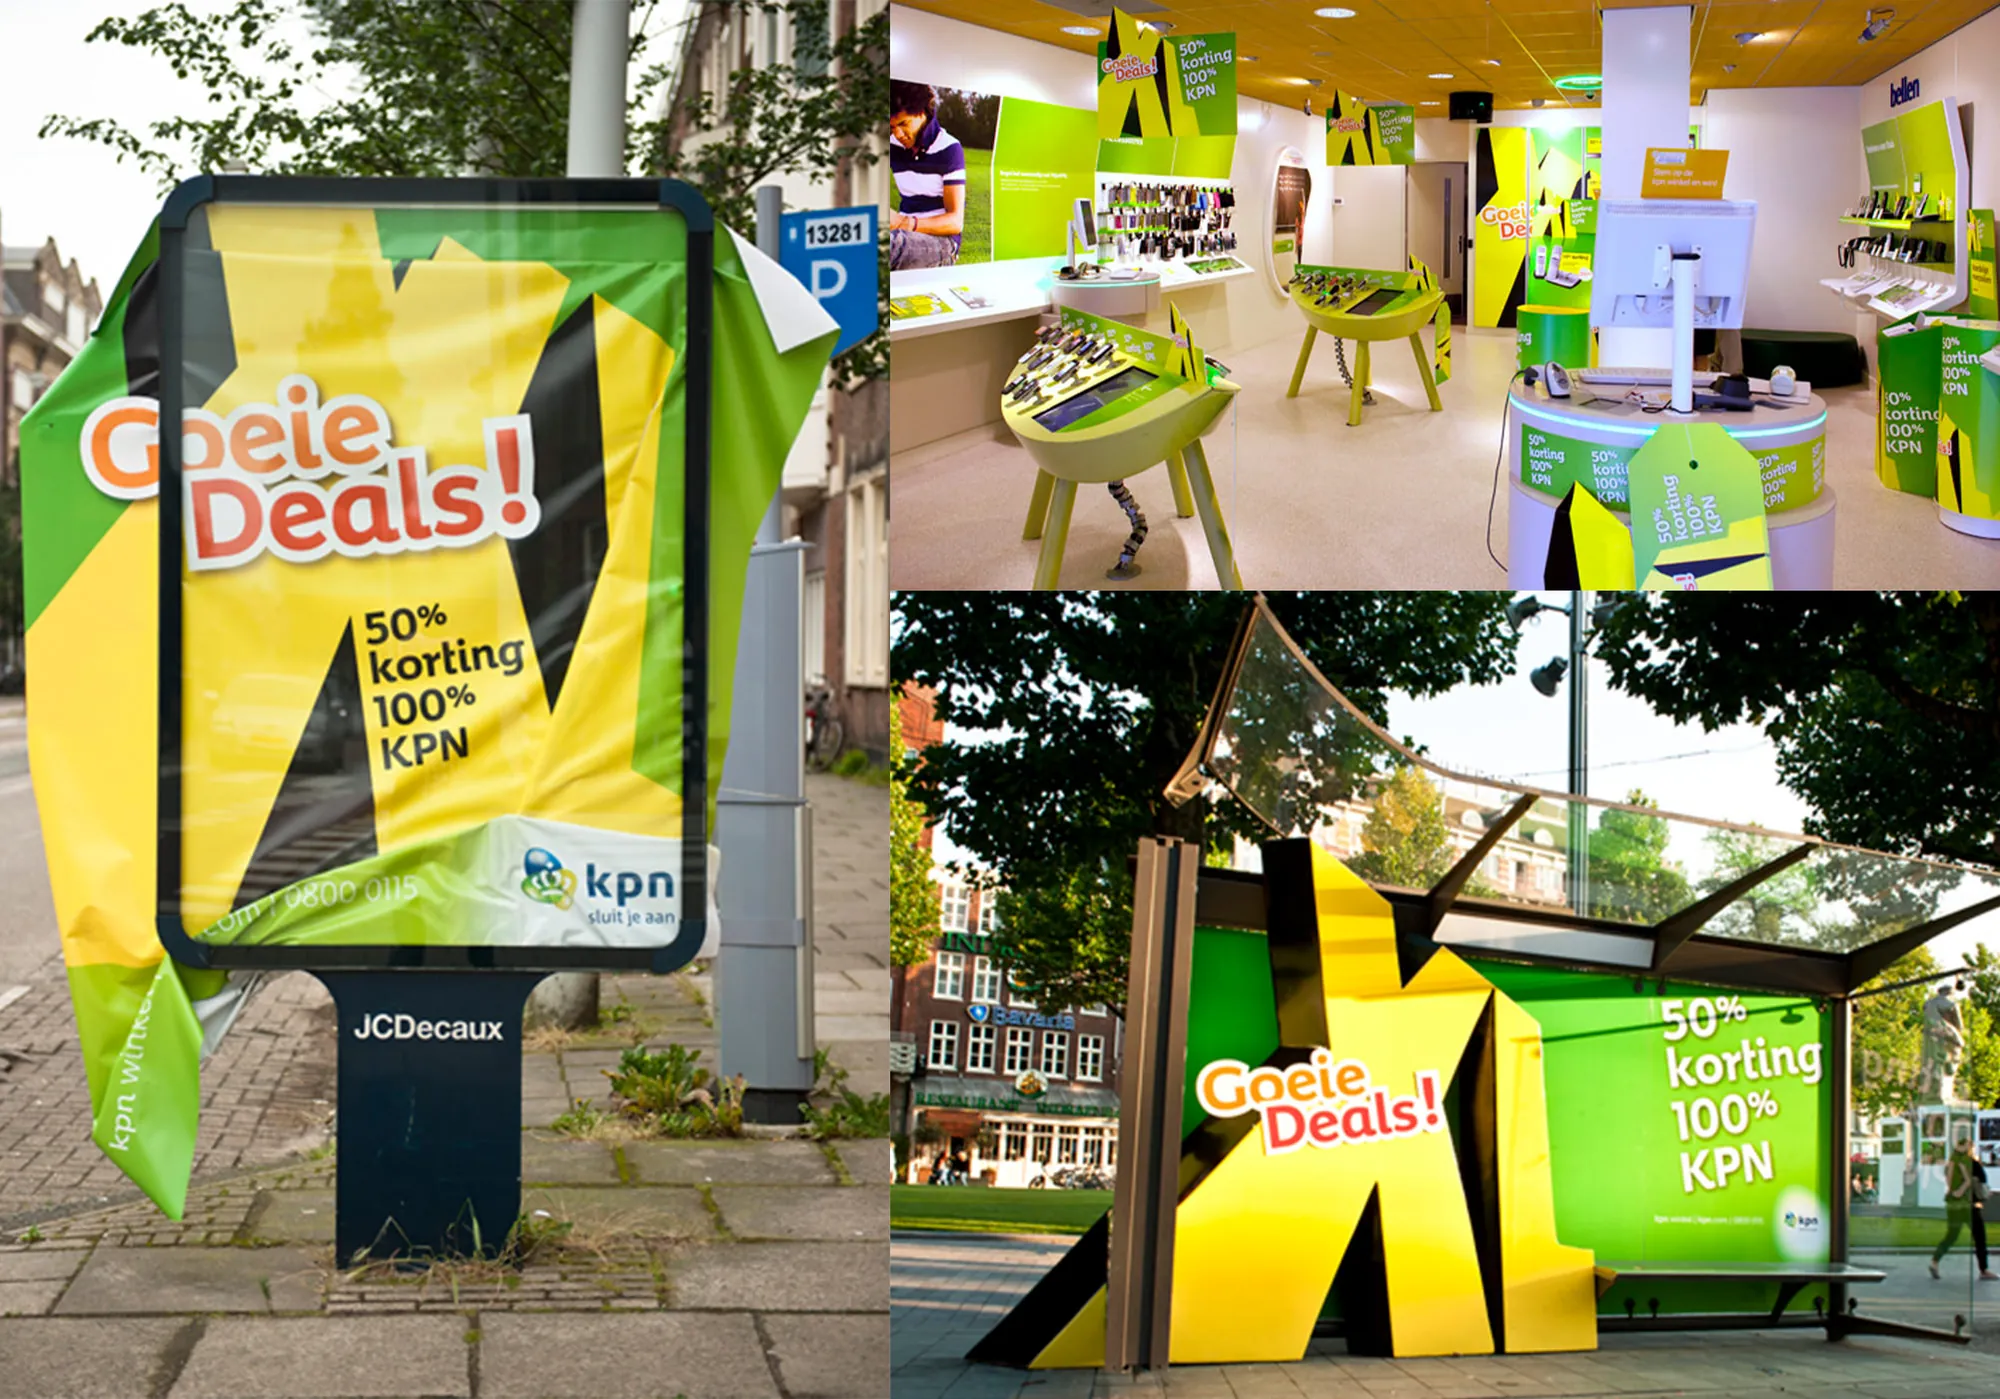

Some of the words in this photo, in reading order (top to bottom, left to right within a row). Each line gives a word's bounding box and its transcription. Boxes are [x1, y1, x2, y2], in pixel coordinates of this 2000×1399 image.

[1102, 54, 1139, 72] Goeie
[1179, 39, 1207, 57] 50%
[1181, 49, 1233, 71] korting
[1115, 58, 1158, 81] Deals!
[1183, 68, 1218, 86] 100%
[1186, 83, 1217, 101] KPN
[1890, 76, 1920, 108] bellen
[1380, 115, 1412, 127] korting
[1383, 135, 1402, 145] KPN
[806, 222, 862, 245] 13281
[811, 259, 848, 300] P
[91, 384, 380, 489] Goeie
[1528, 434, 1546, 446] 50%
[1886, 440, 1923, 454] KPN
[1529, 447, 1565, 464] korting
[1530, 459, 1553, 472] 100%
[1591, 450, 1618, 462] 50%
[191, 428, 527, 559] Deals!
[1531, 473, 1552, 486] KPN
[1594, 477, 1628, 490] 100%
[1597, 491, 1627, 503] KPN
[1663, 474, 1689, 541] korting
[1653, 507, 1673, 544] 50%
[1683, 494, 1707, 539] 100%
[1701, 494, 1724, 534] KPN
[364, 603, 448, 646] 50%
[368, 638, 525, 684] korting
[372, 683, 476, 728] 100%
[381, 727, 470, 771] KPN
[285, 880, 357, 909] 0800
[364, 875, 419, 901] 0115
[586, 863, 675, 907] kpn
[587, 909, 625, 925] sluit
[627, 910, 642, 927] je
[645, 912, 676, 924] aan
[353, 1013, 504, 1042] JCDecaux
[1661, 995, 1747, 1041] 50%
[1666, 1036, 1822, 1089] korting
[1203, 1054, 1366, 1111] Goeie
[109, 1093, 137, 1151] kpn
[1266, 1077, 1439, 1149] Deals!
[1670, 1089, 1779, 1142] 100%
[1680, 1140, 1774, 1194] KPN
